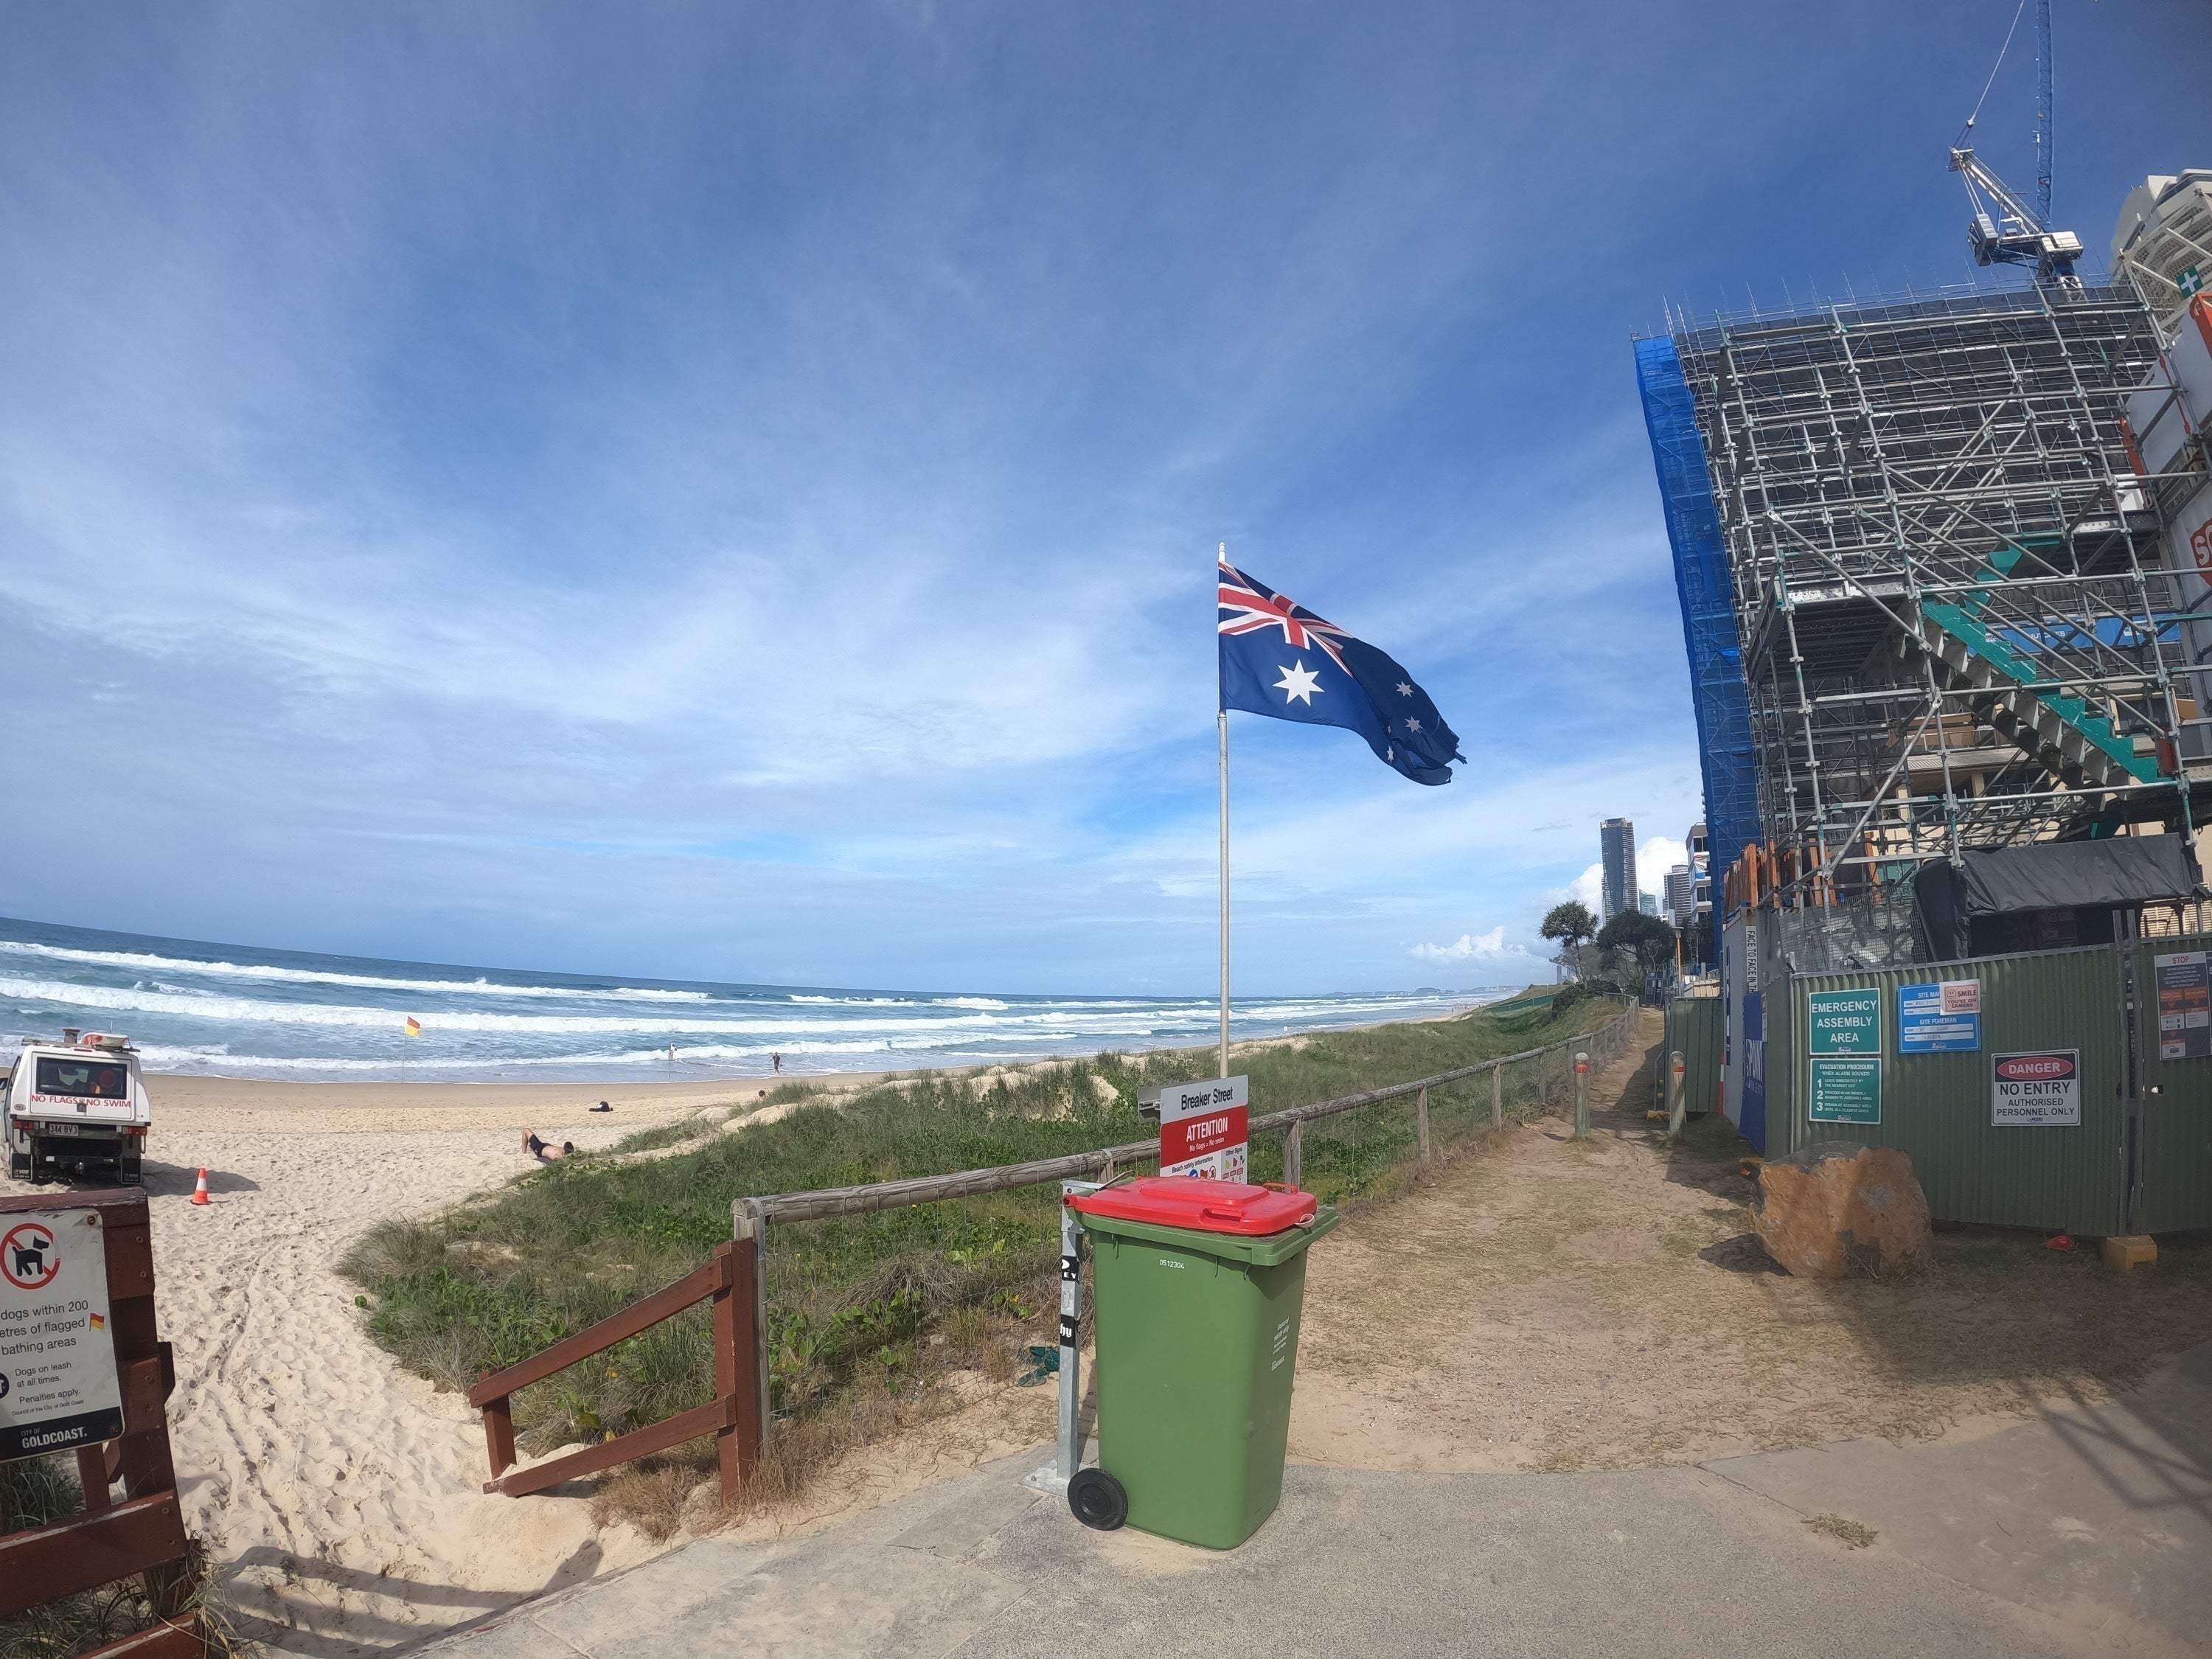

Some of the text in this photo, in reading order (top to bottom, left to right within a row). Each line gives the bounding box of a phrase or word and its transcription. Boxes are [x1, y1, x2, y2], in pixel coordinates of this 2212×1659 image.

[1747, 931, 1756, 947] FACE
[1747, 949, 1756, 957] TO
[2172, 956, 2190, 964] STOP
[1747, 959, 1756, 975] FACE
[1812, 1000, 1877, 1013] EMERGENCY
[1817, 1016, 1873, 1028] ASSEMBLY
[1830, 1032, 1860, 1043] AREA
[2008, 1062, 2060, 1074] DANGER
[1817, 1078, 1821, 1088] 1
[2000, 1082, 2070, 1096] NO ENTRY
[49, 1096, 78, 1105] FLAGS
[1181, 1087, 1233, 1110] Breaker Street
[1817, 1090, 1823, 1100] 2
[1816, 1102, 1823, 1111] 3
[1997, 1108, 2048, 1116] PERSONNEL
[1186, 1116, 1228, 1142] ATTENTION
[1196, 1141, 1205, 1150] flags
[1172, 1156, 1214, 1174] Beach safety information
[1159, 1259, 1184, 1270] 0512304
[1, 1300, 88, 1321] dogs within 200
[0, 1318, 85, 1338] etres of flagged
[1, 1338, 77, 1355] bathing areas
[15, 1368, 37, 1377] Dogs
[51, 1362, 72, 1371] leash
[27, 1377, 35, 1386] all
[38, 1375, 62, 1385] times.
[19, 1393, 56, 1404] Penalties
